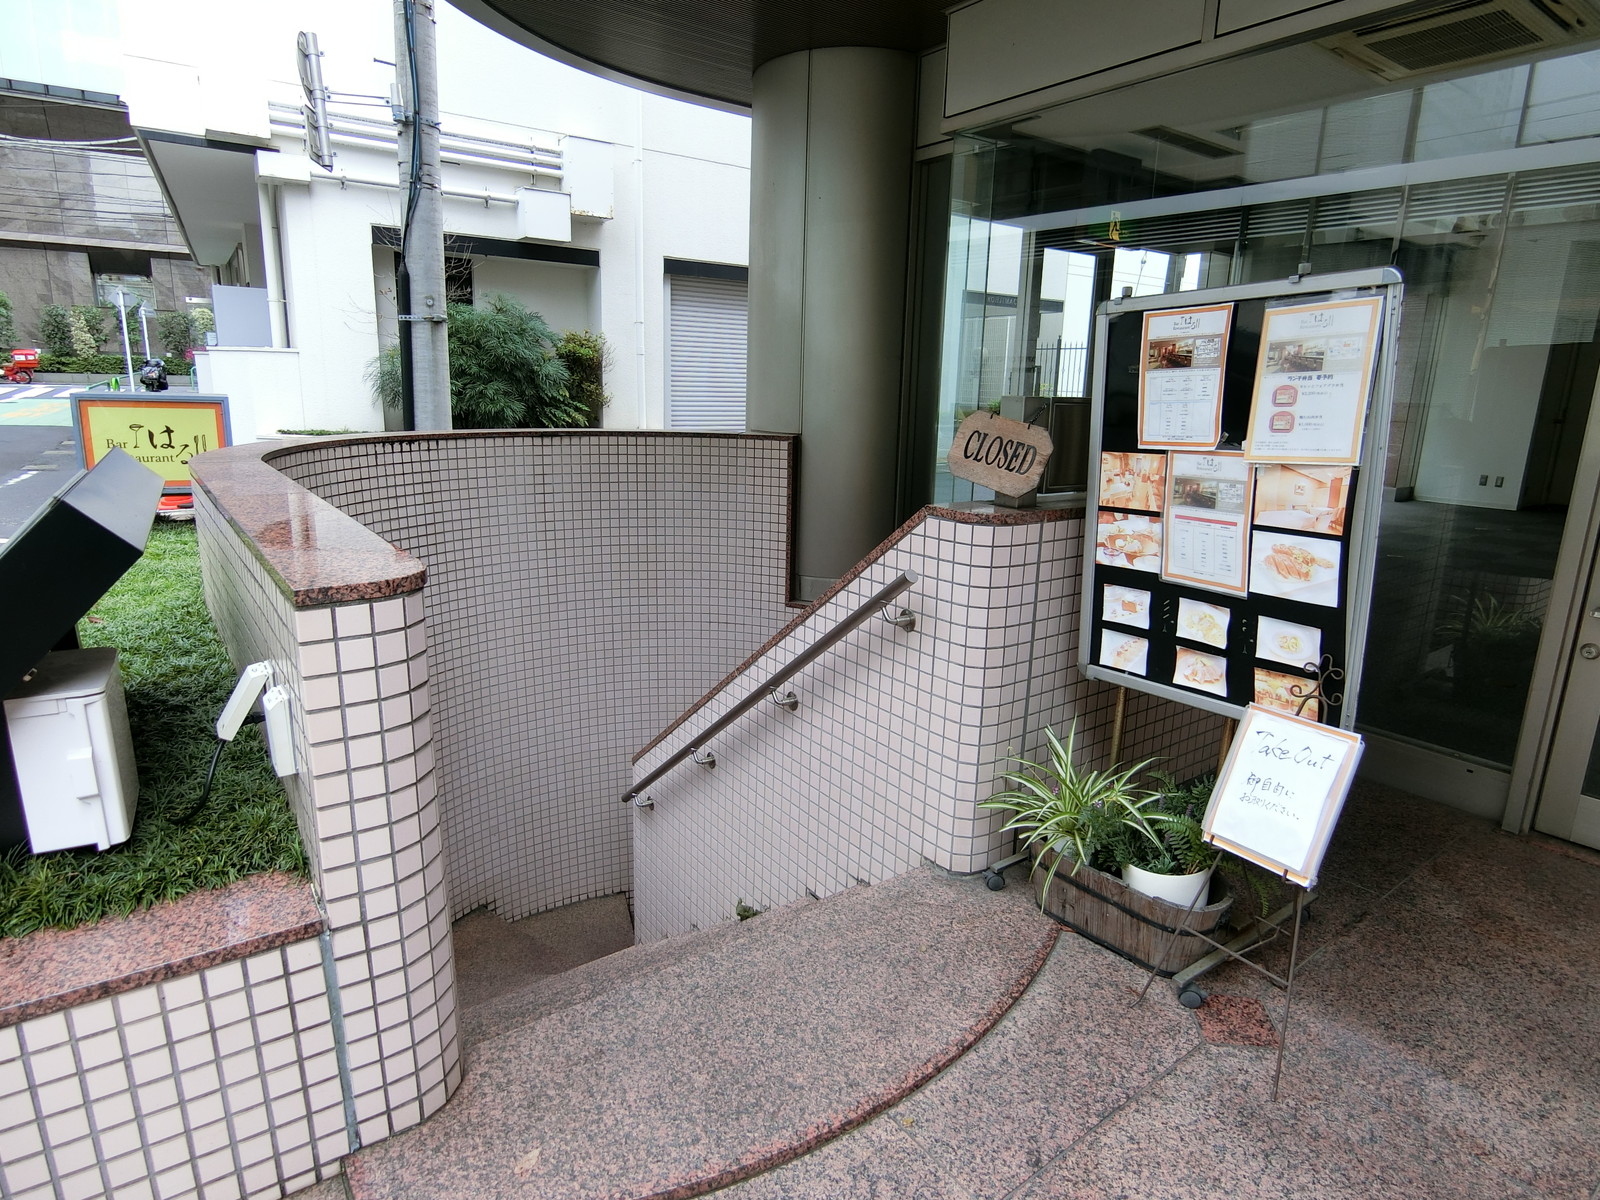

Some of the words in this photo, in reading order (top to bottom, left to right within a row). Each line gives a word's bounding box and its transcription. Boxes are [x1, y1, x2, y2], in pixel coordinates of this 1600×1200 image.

[106, 438, 128, 449] Bar
[963, 430, 1037, 475] CLOSED
[135, 454, 175, 463] aurant
[1256, 731, 1292, 760] Take
[1294, 746, 1335, 769] Out
